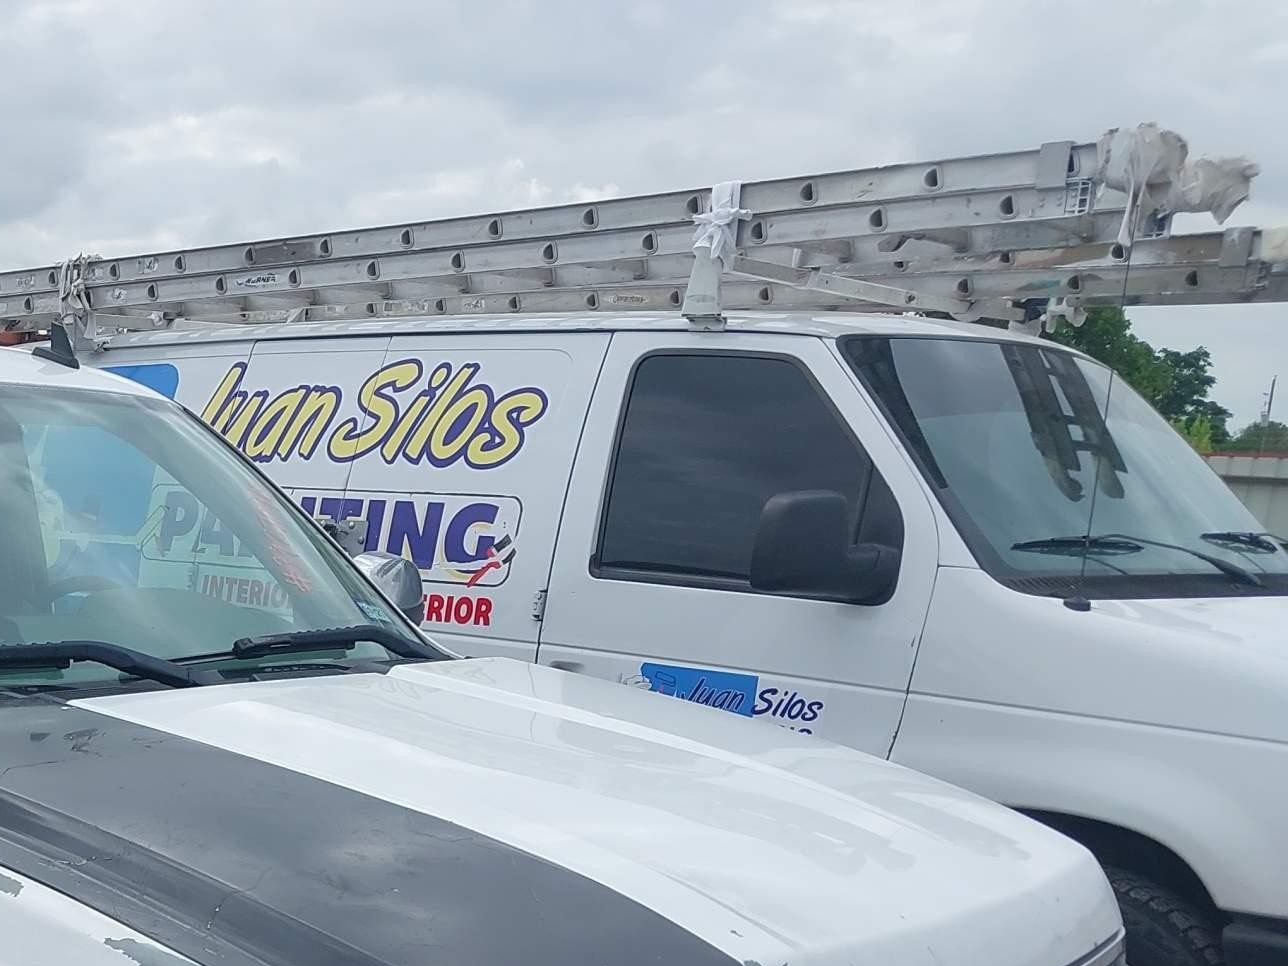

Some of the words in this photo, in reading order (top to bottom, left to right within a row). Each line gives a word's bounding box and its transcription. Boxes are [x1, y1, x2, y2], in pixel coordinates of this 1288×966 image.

[200, 361, 343, 463] Juan
[327, 358, 549, 470] Silos
[157, 490, 500, 574] PATING
[202, 573, 296, 607] INTERIO
[680, 678, 745, 711] Juan
[750, 688, 824, 721] Silos
